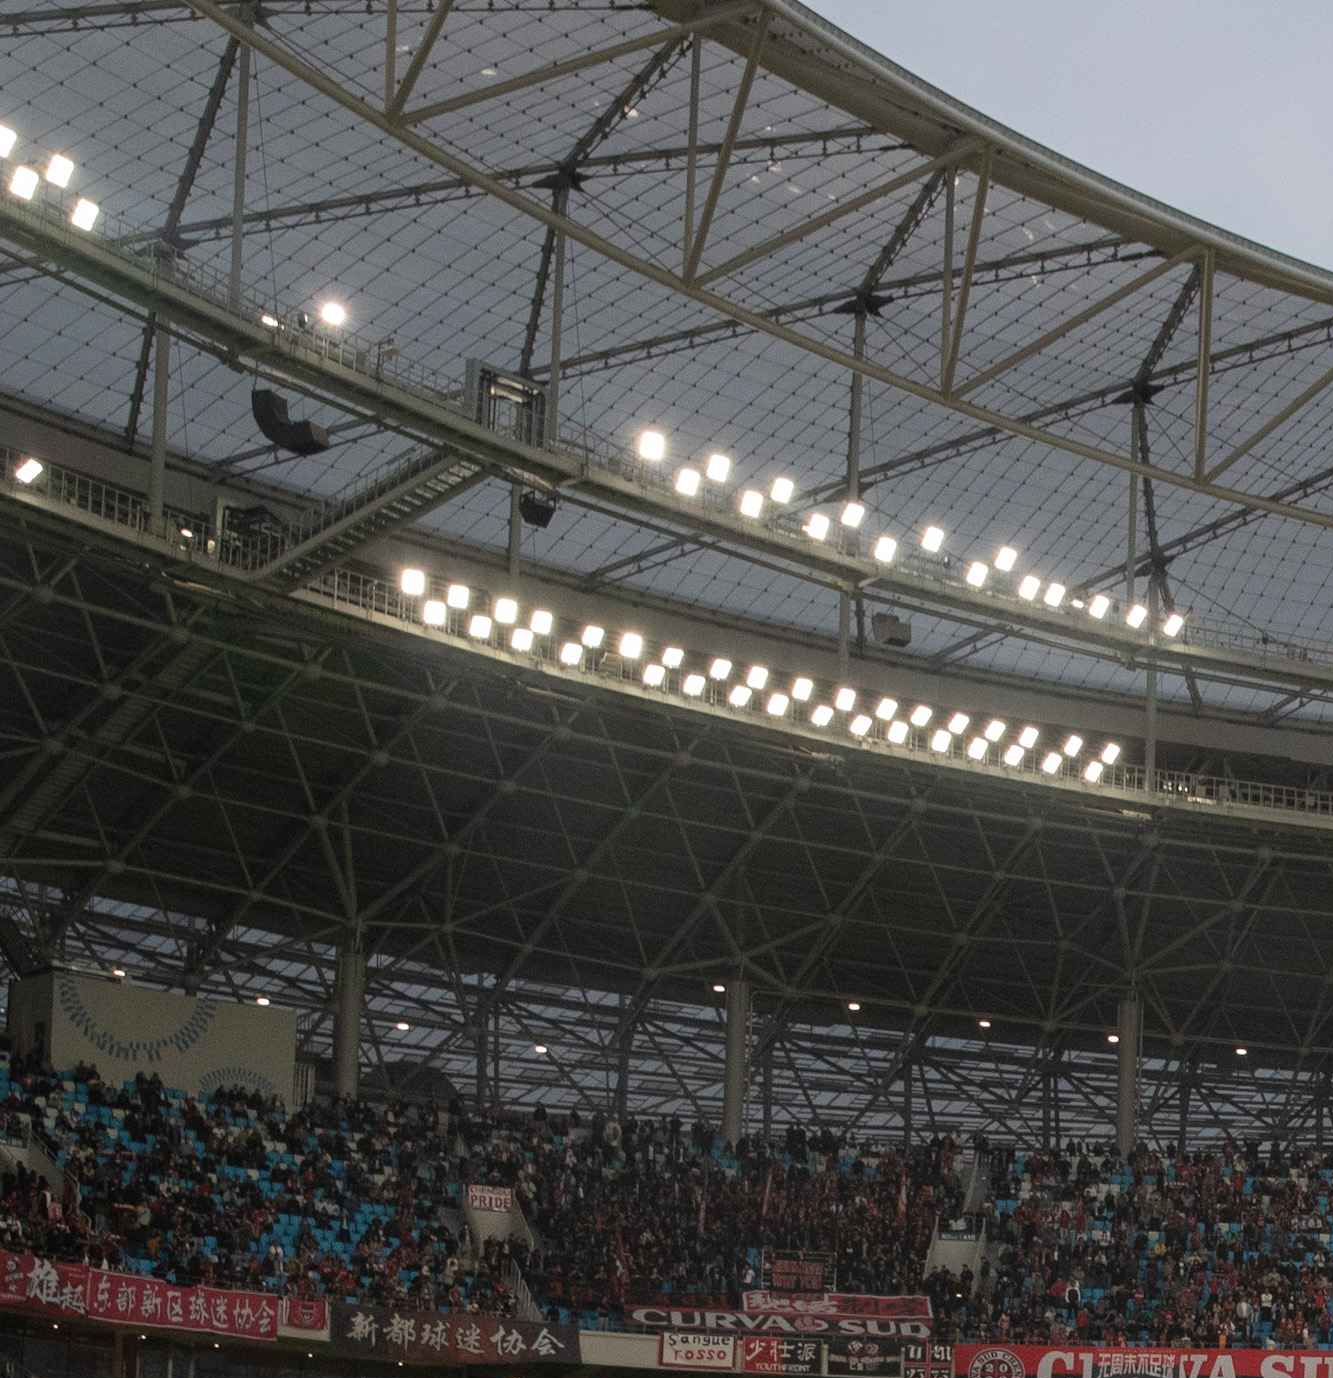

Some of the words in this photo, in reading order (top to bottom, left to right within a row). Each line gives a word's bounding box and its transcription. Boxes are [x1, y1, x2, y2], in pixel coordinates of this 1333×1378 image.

[471, 1195, 512, 1209] PRIDE
[93, 1274, 275, 1334] 东部新区球迷协会
[347, 1309, 565, 1358] 新都球迷协会
[632, 1308, 797, 1333] CURVA
[838, 1319, 932, 1339] SUD
[674, 1349, 727, 1361] rosso
